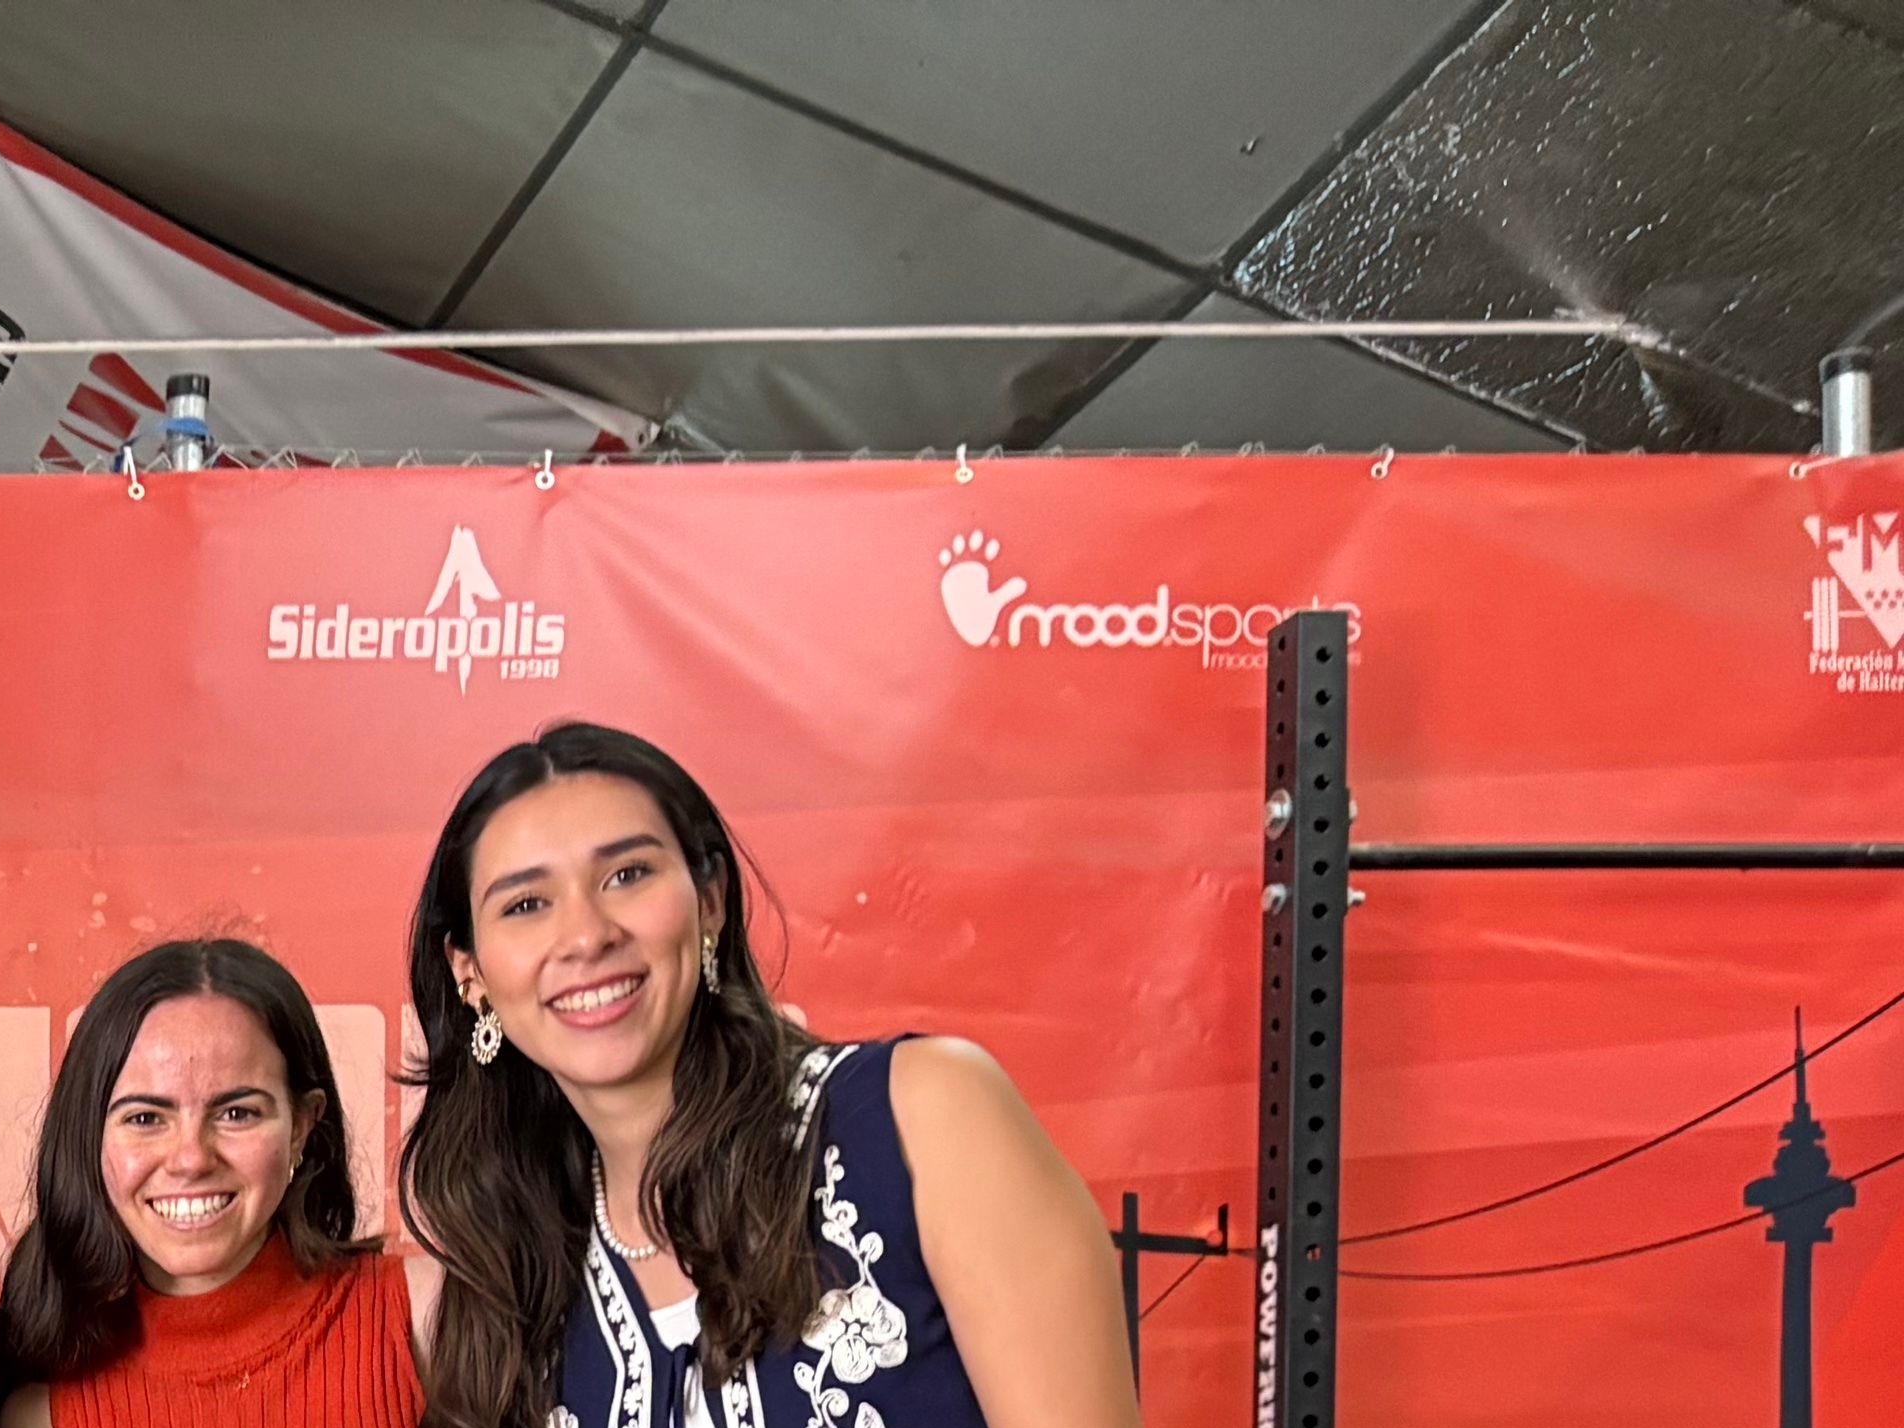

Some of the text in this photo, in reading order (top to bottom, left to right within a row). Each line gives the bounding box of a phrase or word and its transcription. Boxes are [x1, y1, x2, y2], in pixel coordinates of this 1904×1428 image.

[267, 601, 565, 673] Sideropolis
[1809, 650, 1893, 674] Federación
[1837, 671, 1856, 693] de
